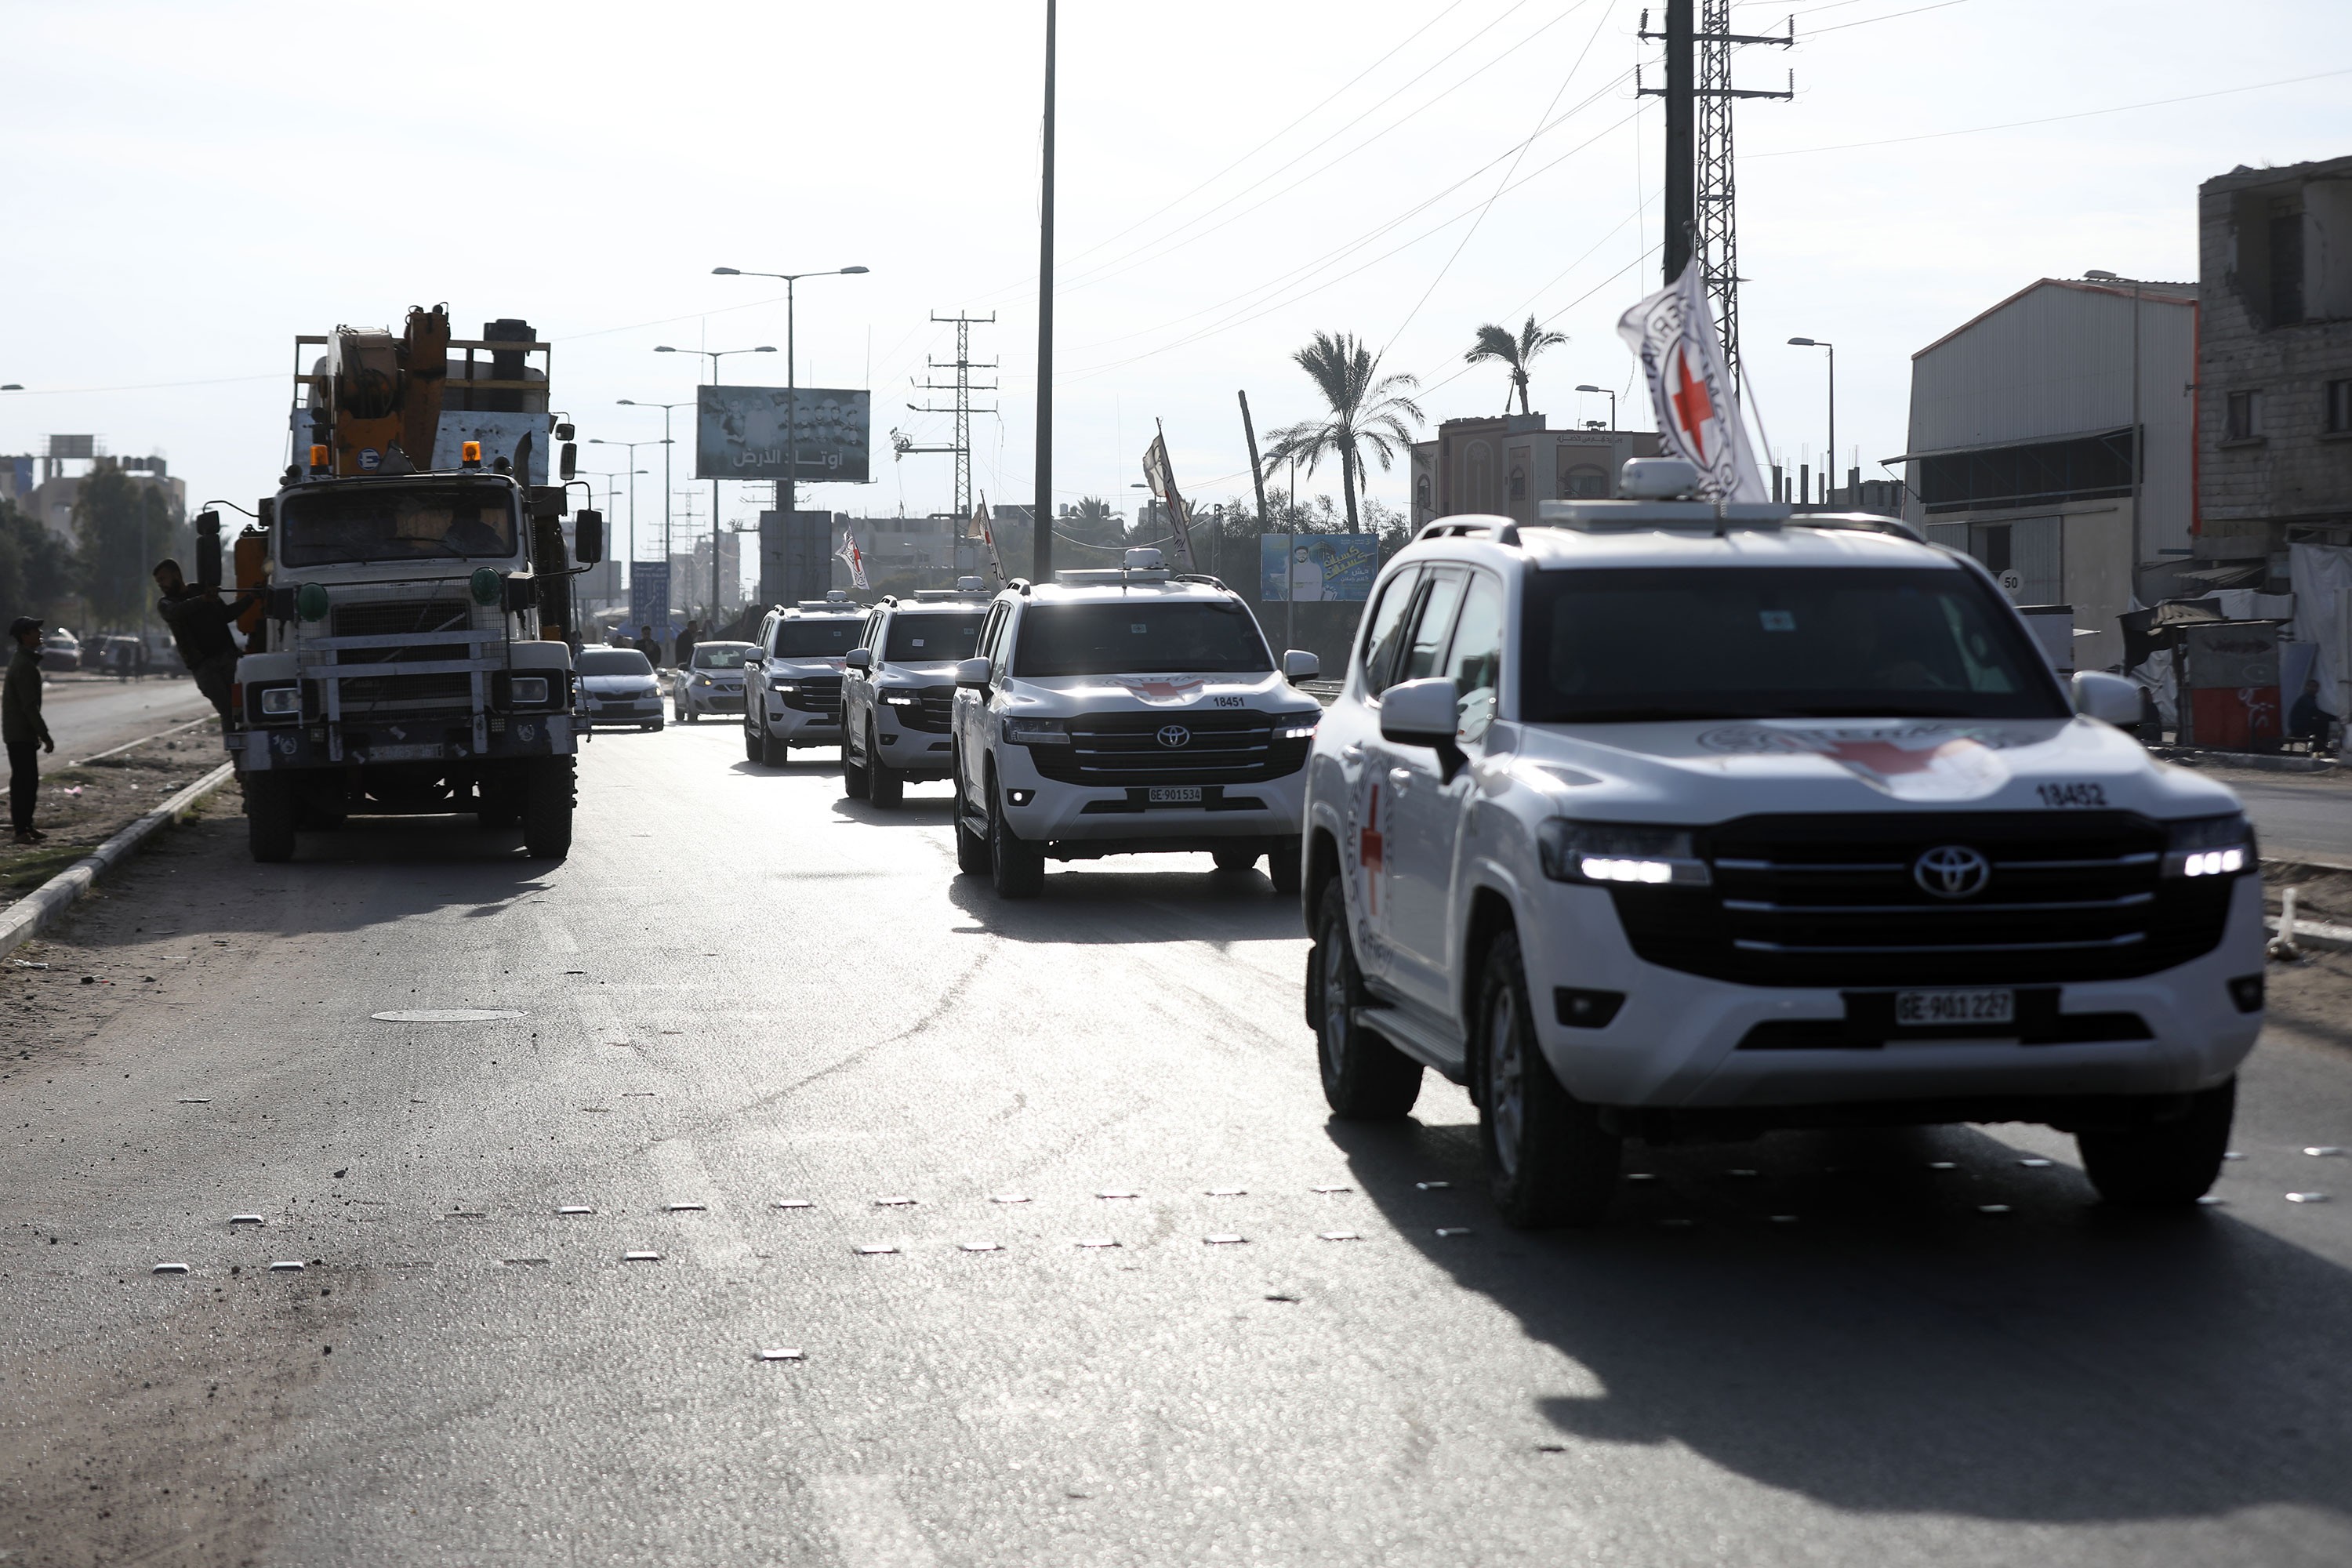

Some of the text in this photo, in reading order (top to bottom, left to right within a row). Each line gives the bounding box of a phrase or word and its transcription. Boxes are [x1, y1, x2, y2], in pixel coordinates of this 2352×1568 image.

[732, 448, 780, 468] الأرض
[2004, 577, 2018, 589] 50
[1213, 696, 1245, 707] 18451
[2036, 782, 2112, 808] 18452
